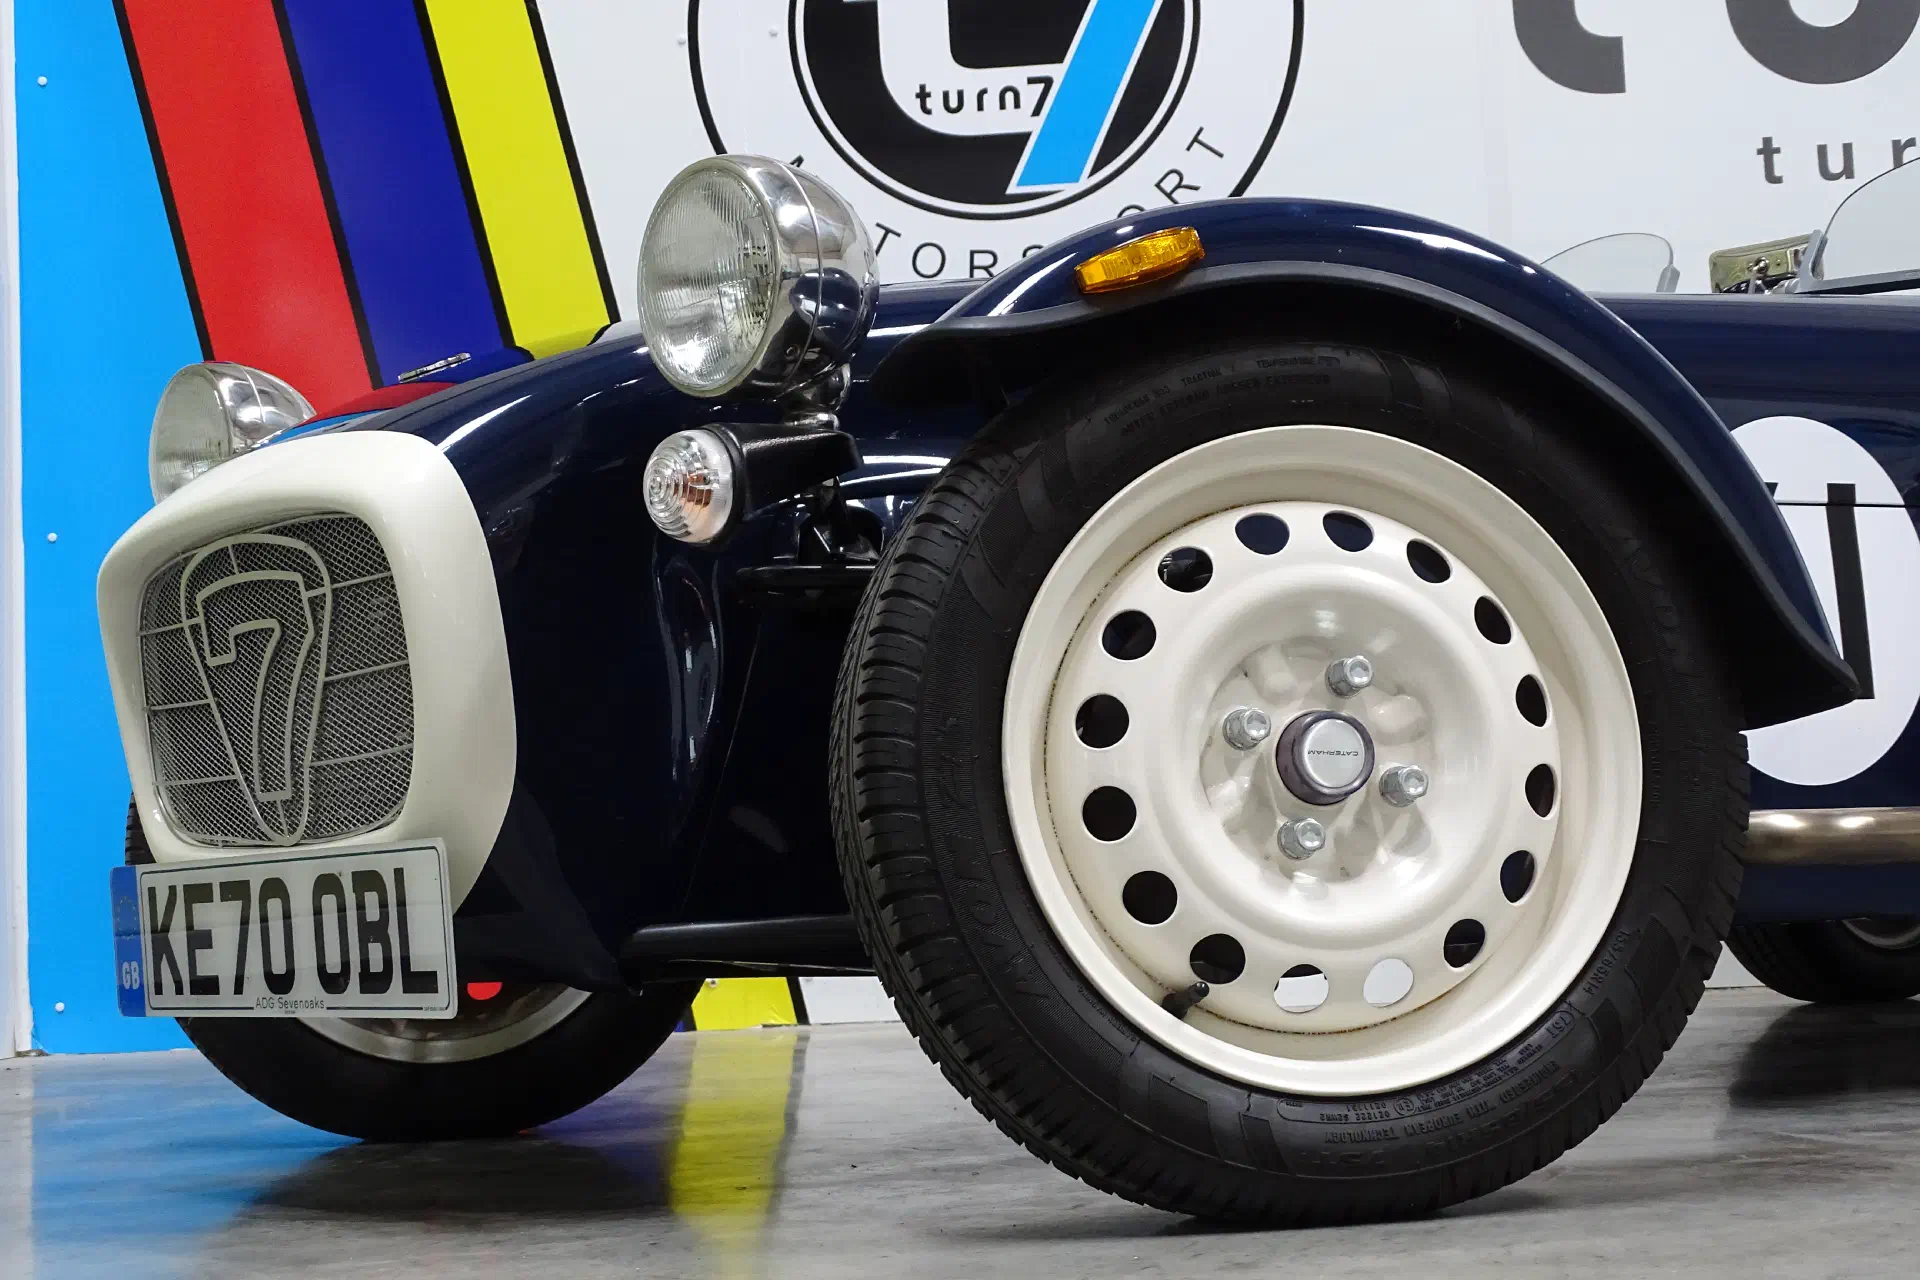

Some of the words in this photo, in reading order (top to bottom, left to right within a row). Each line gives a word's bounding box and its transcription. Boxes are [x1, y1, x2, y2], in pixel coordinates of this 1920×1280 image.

[914, 75, 1055, 117] turn7
[1307, 749, 1359, 757] CATERHAM
[148, 877, 295, 995] KE70
[122, 960, 140, 990] GB
[256, 997, 275, 1009] ADG
[277, 996, 325, 1009] Sevenoaks
